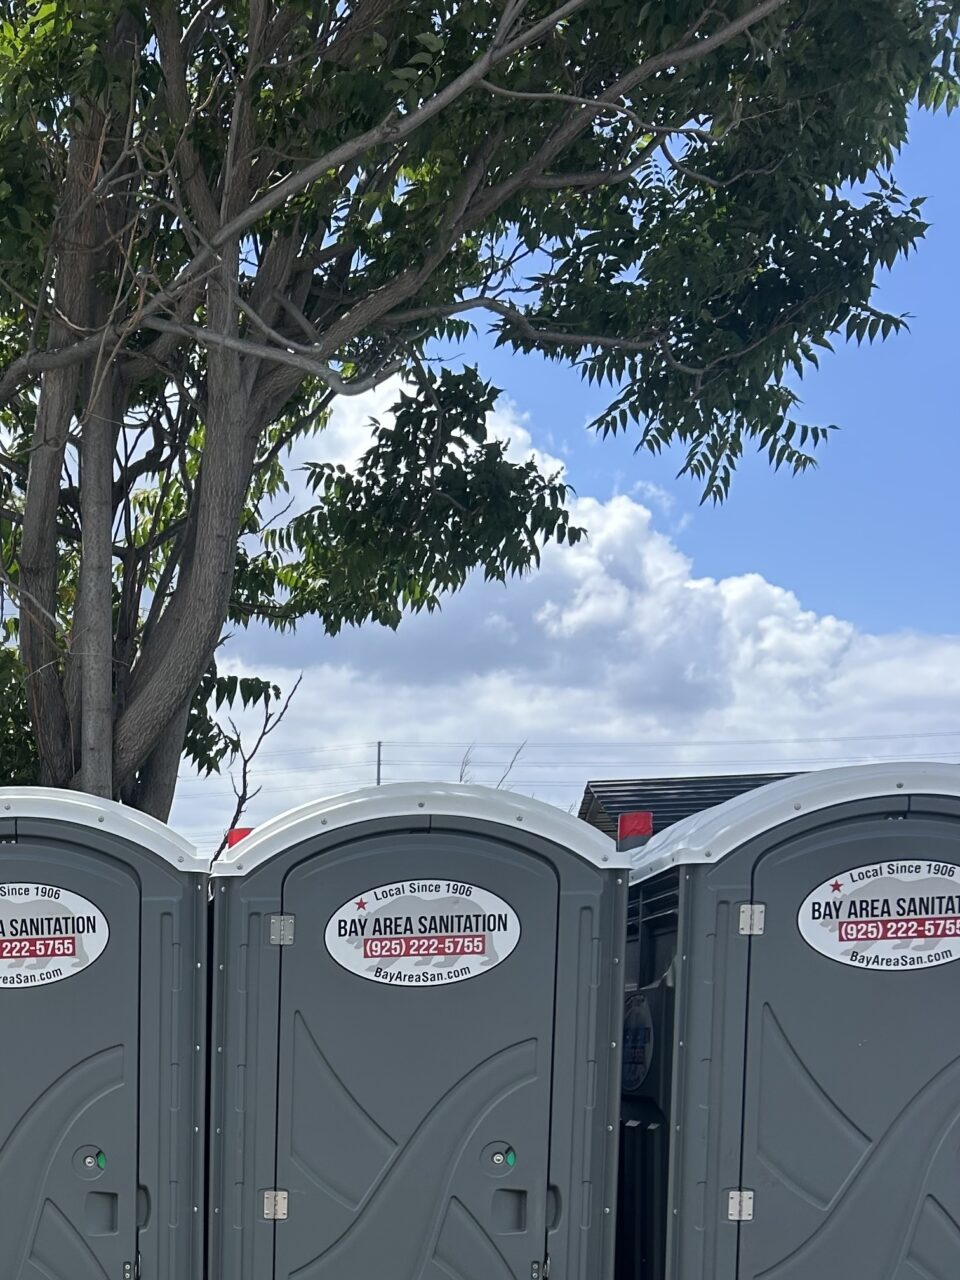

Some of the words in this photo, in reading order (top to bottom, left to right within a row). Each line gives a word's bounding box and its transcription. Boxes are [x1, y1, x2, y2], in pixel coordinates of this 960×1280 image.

[850, 866, 883, 883] Local
[887, 863, 921, 874] Since
[926, 863, 956, 877] 1906
[0, 886, 30, 897] Since
[34, 886, 61, 900] 1906
[373, 884, 405, 901] Local
[409, 883, 441, 893] Since
[445, 883, 473, 897] 1906
[811, 901, 843, 920] BAY
[847, 899, 891, 918] AREA
[9, 916, 96, 937] SANITATION
[338, 918, 368, 937] BAY
[372, 916, 414, 936] AREA
[418, 914, 508, 934] SANITATION
[841, 922, 883, 940] (925)
[2, 939, 73, 956] 222-5755
[366, 939, 406, 956] (925)
[409, 937, 483, 955] 222-5755
[850, 949, 953, 967] BayAreaSan.com
[374, 966, 471, 983] BayAreaSan.com
